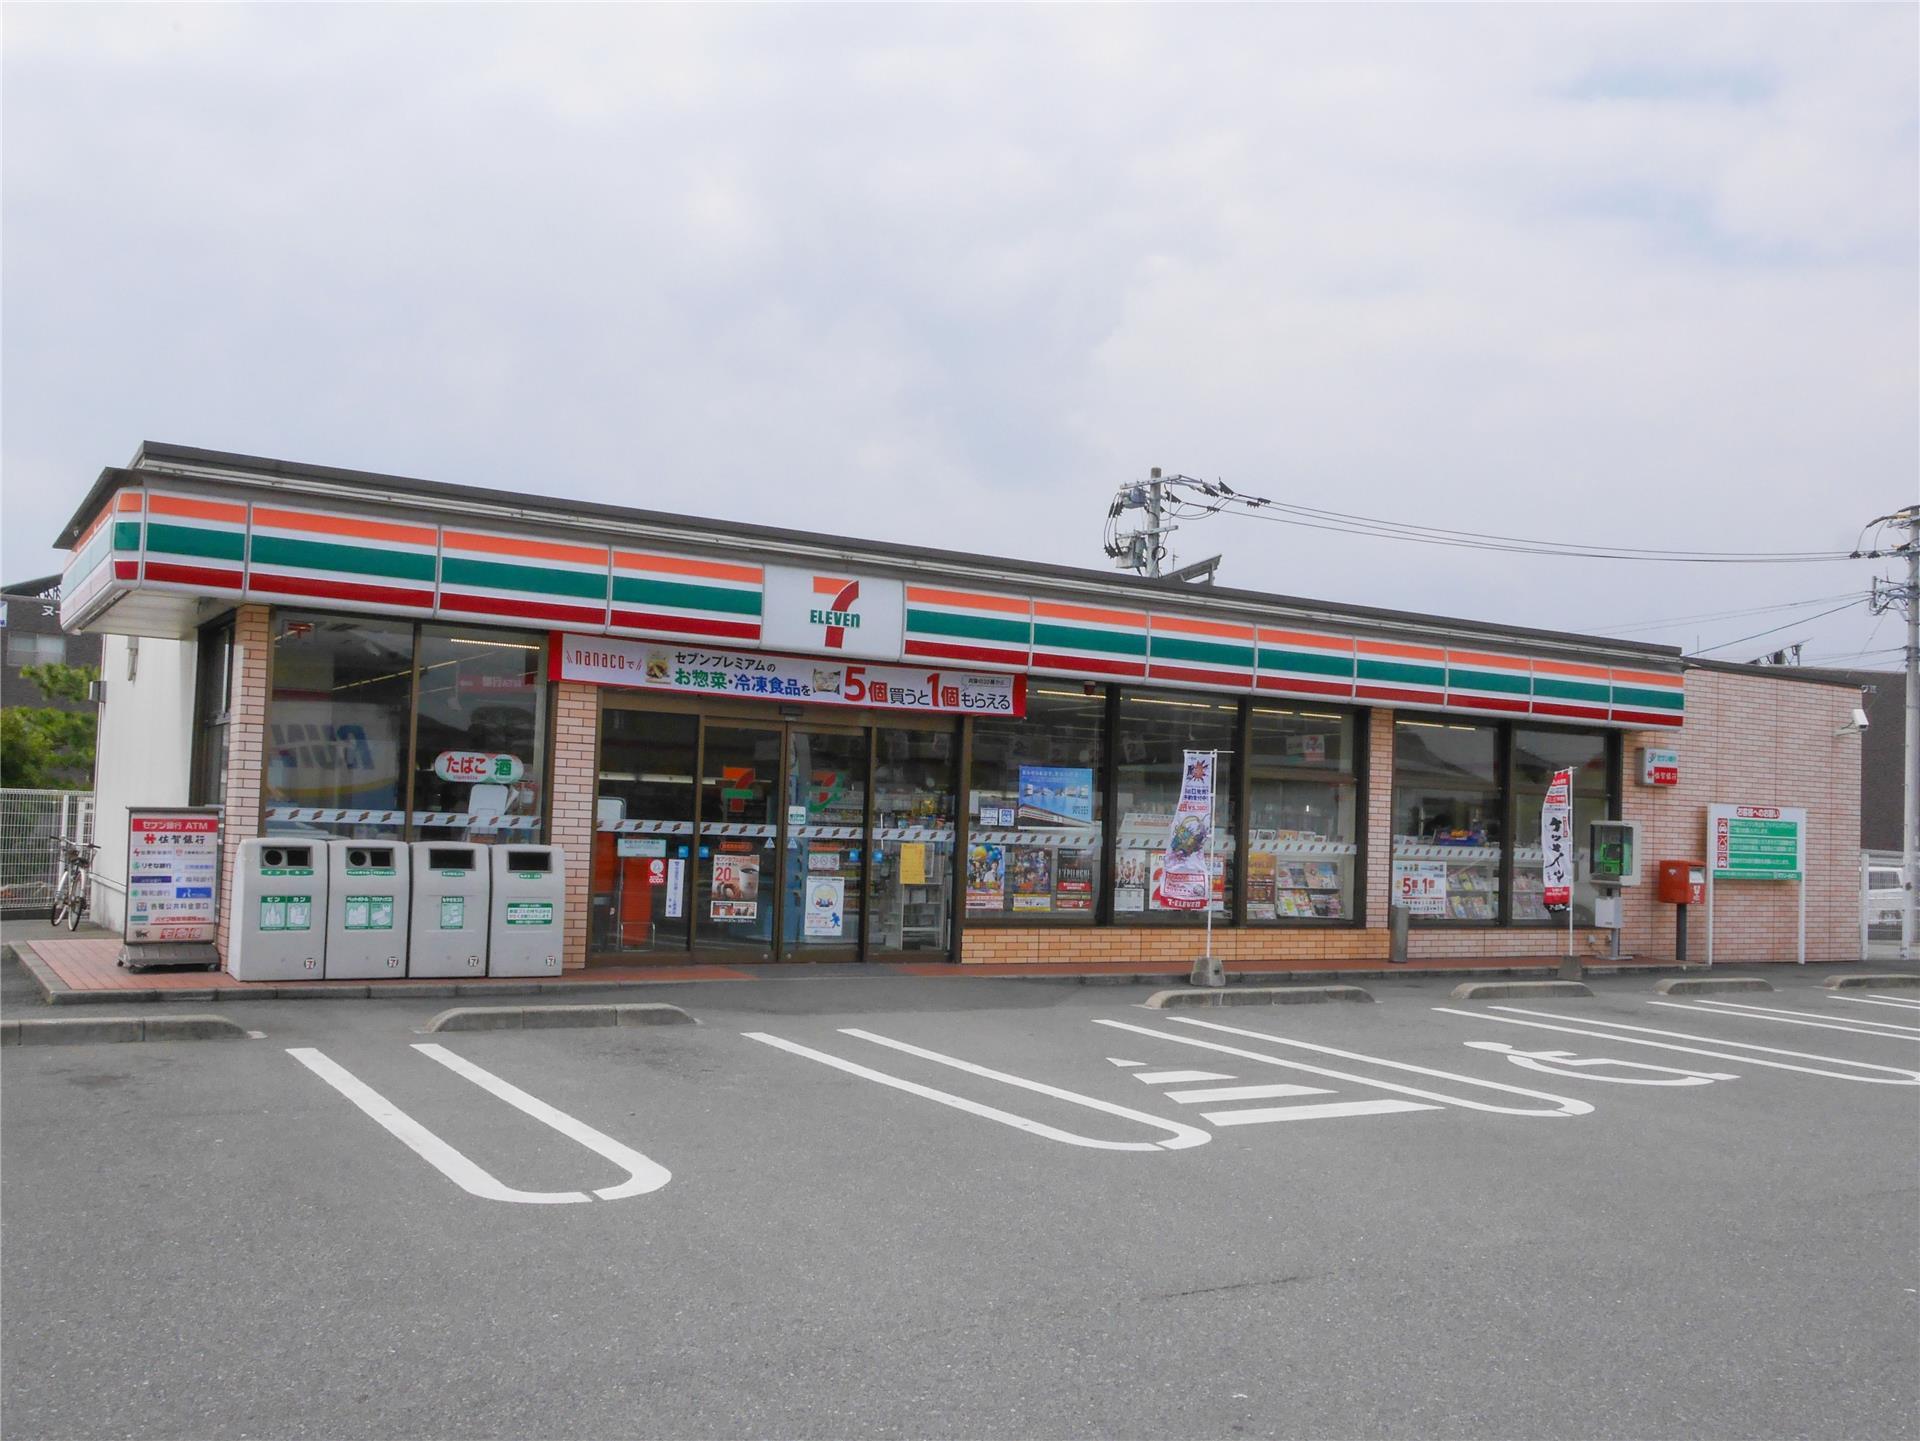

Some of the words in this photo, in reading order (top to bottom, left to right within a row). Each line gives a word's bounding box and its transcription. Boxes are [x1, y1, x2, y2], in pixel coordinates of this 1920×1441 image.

[813, 576, 859, 648] 7
[675, 651, 776, 672] セブンプレミアムの
[675, 668, 811, 697] お惣菜・冷凍食品を
[446, 755, 487, 774] たばこ
[494, 758, 513, 776] 酒
[185, 822, 208, 830] ATM
[158, 834, 205, 844] 佐賀銀行
[716, 867, 731, 881] 20
